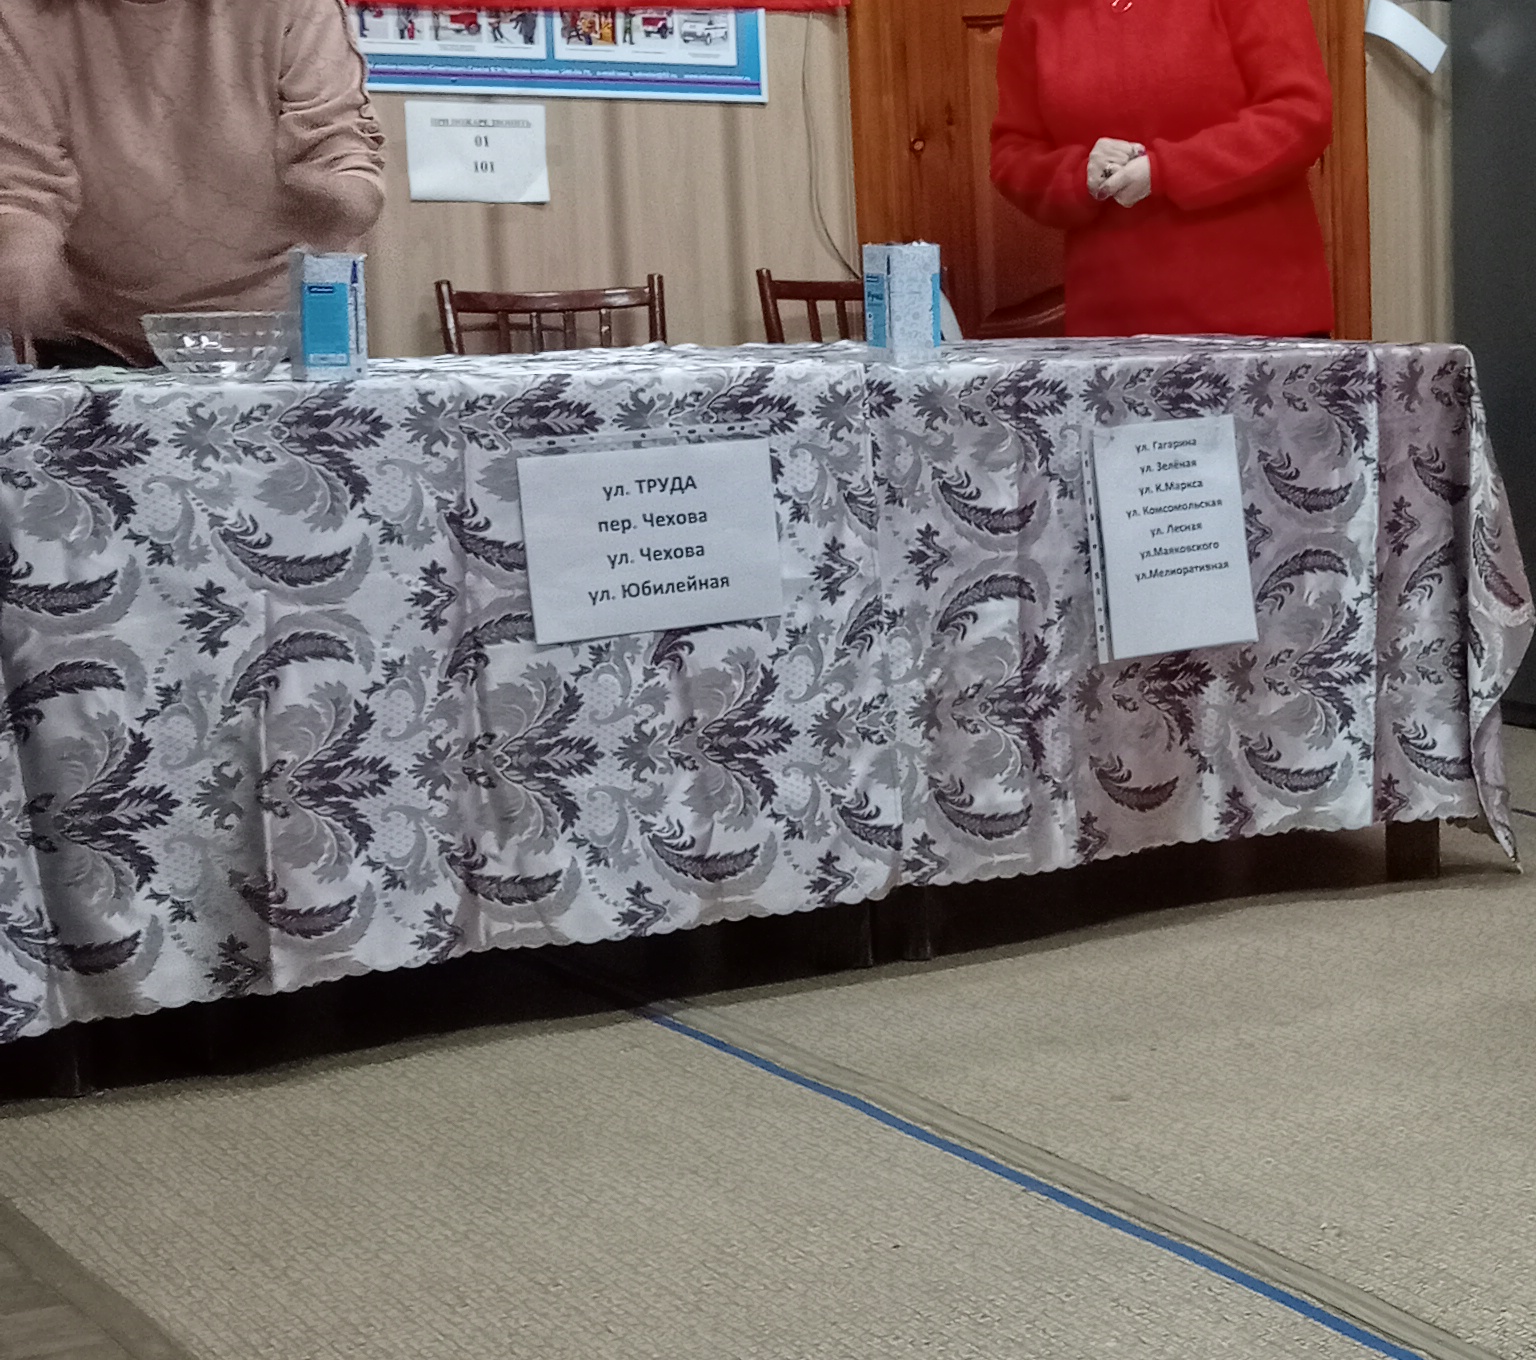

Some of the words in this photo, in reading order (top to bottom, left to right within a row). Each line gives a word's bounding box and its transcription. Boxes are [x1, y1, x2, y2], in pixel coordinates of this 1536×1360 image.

[474, 135, 490, 148] 01
[473, 160, 495, 174] 101
[1134, 444, 1150, 455] ул.
[1152, 437, 1197, 451] Гагарина
[1156, 458, 1197, 472] Зелёная
[602, 484, 630, 502] ул.
[634, 474, 698, 496] ТРУДА
[1138, 485, 1154, 497] ул.
[1125, 509, 1141, 520] ул.
[1142, 497, 1223, 516] Комсомольская
[597, 518, 638, 536] пер.
[641, 510, 708, 529] Чехова
[1149, 527, 1165, 538] ул.
[1166, 521, 1203, 535] Лесная
[606, 552, 635, 570] ул.
[639, 544, 705, 562] Чехова
[587, 589, 616, 607] ул.
[621, 574, 730, 600] Юбилейная
